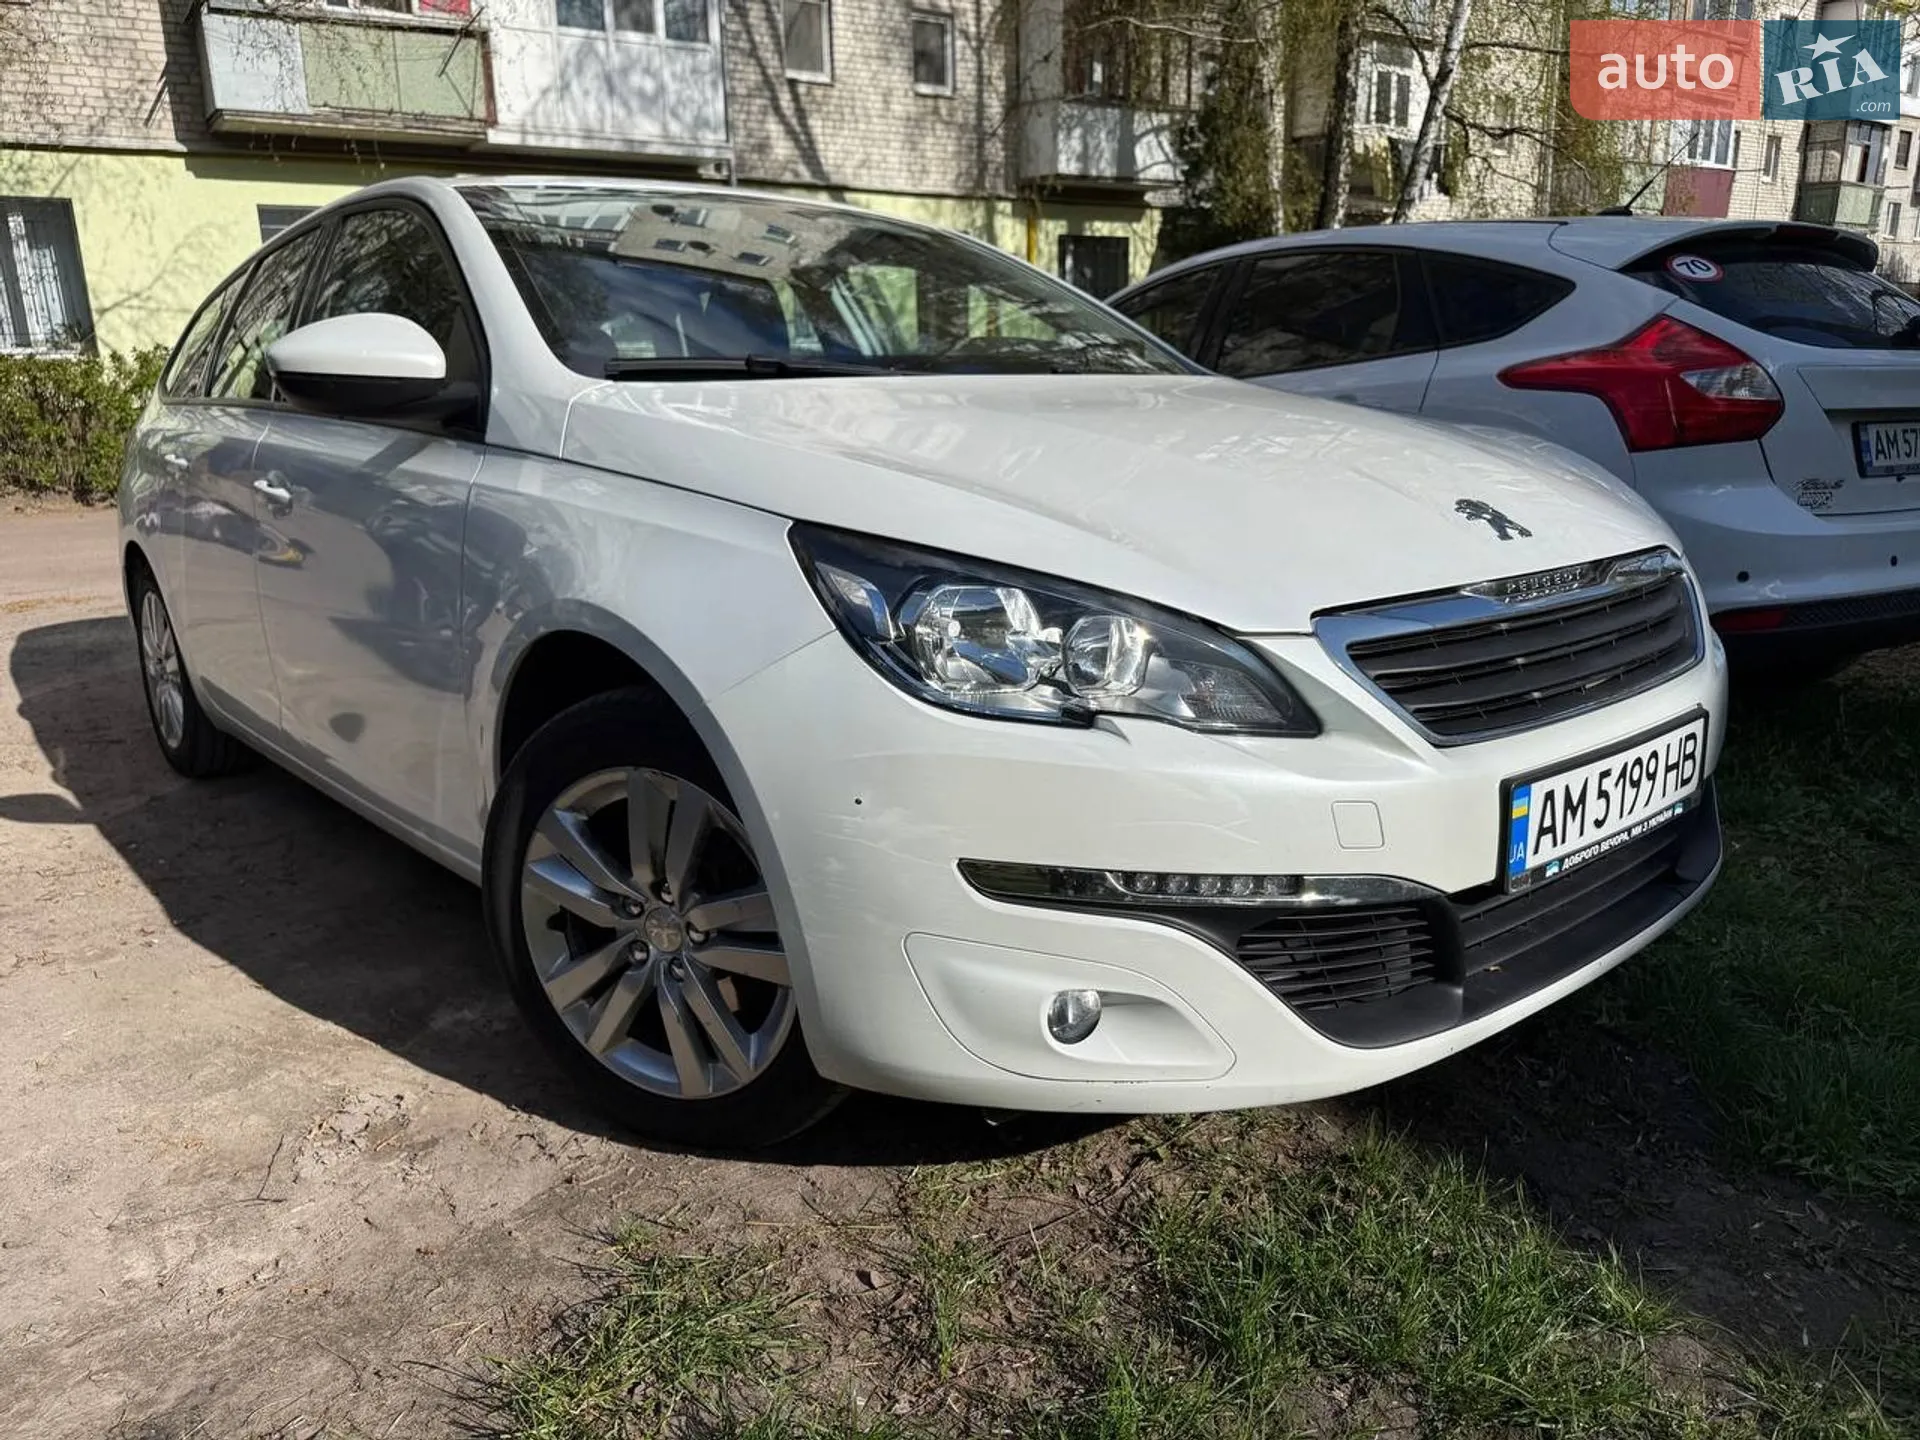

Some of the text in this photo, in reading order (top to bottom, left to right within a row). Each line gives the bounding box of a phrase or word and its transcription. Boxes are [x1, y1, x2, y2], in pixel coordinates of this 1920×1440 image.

[1676, 260, 1711, 275] 70
[1875, 429, 1900, 460] AM
[1902, 428, 1920, 458] 57
[1593, 750, 1659, 829] 5199
